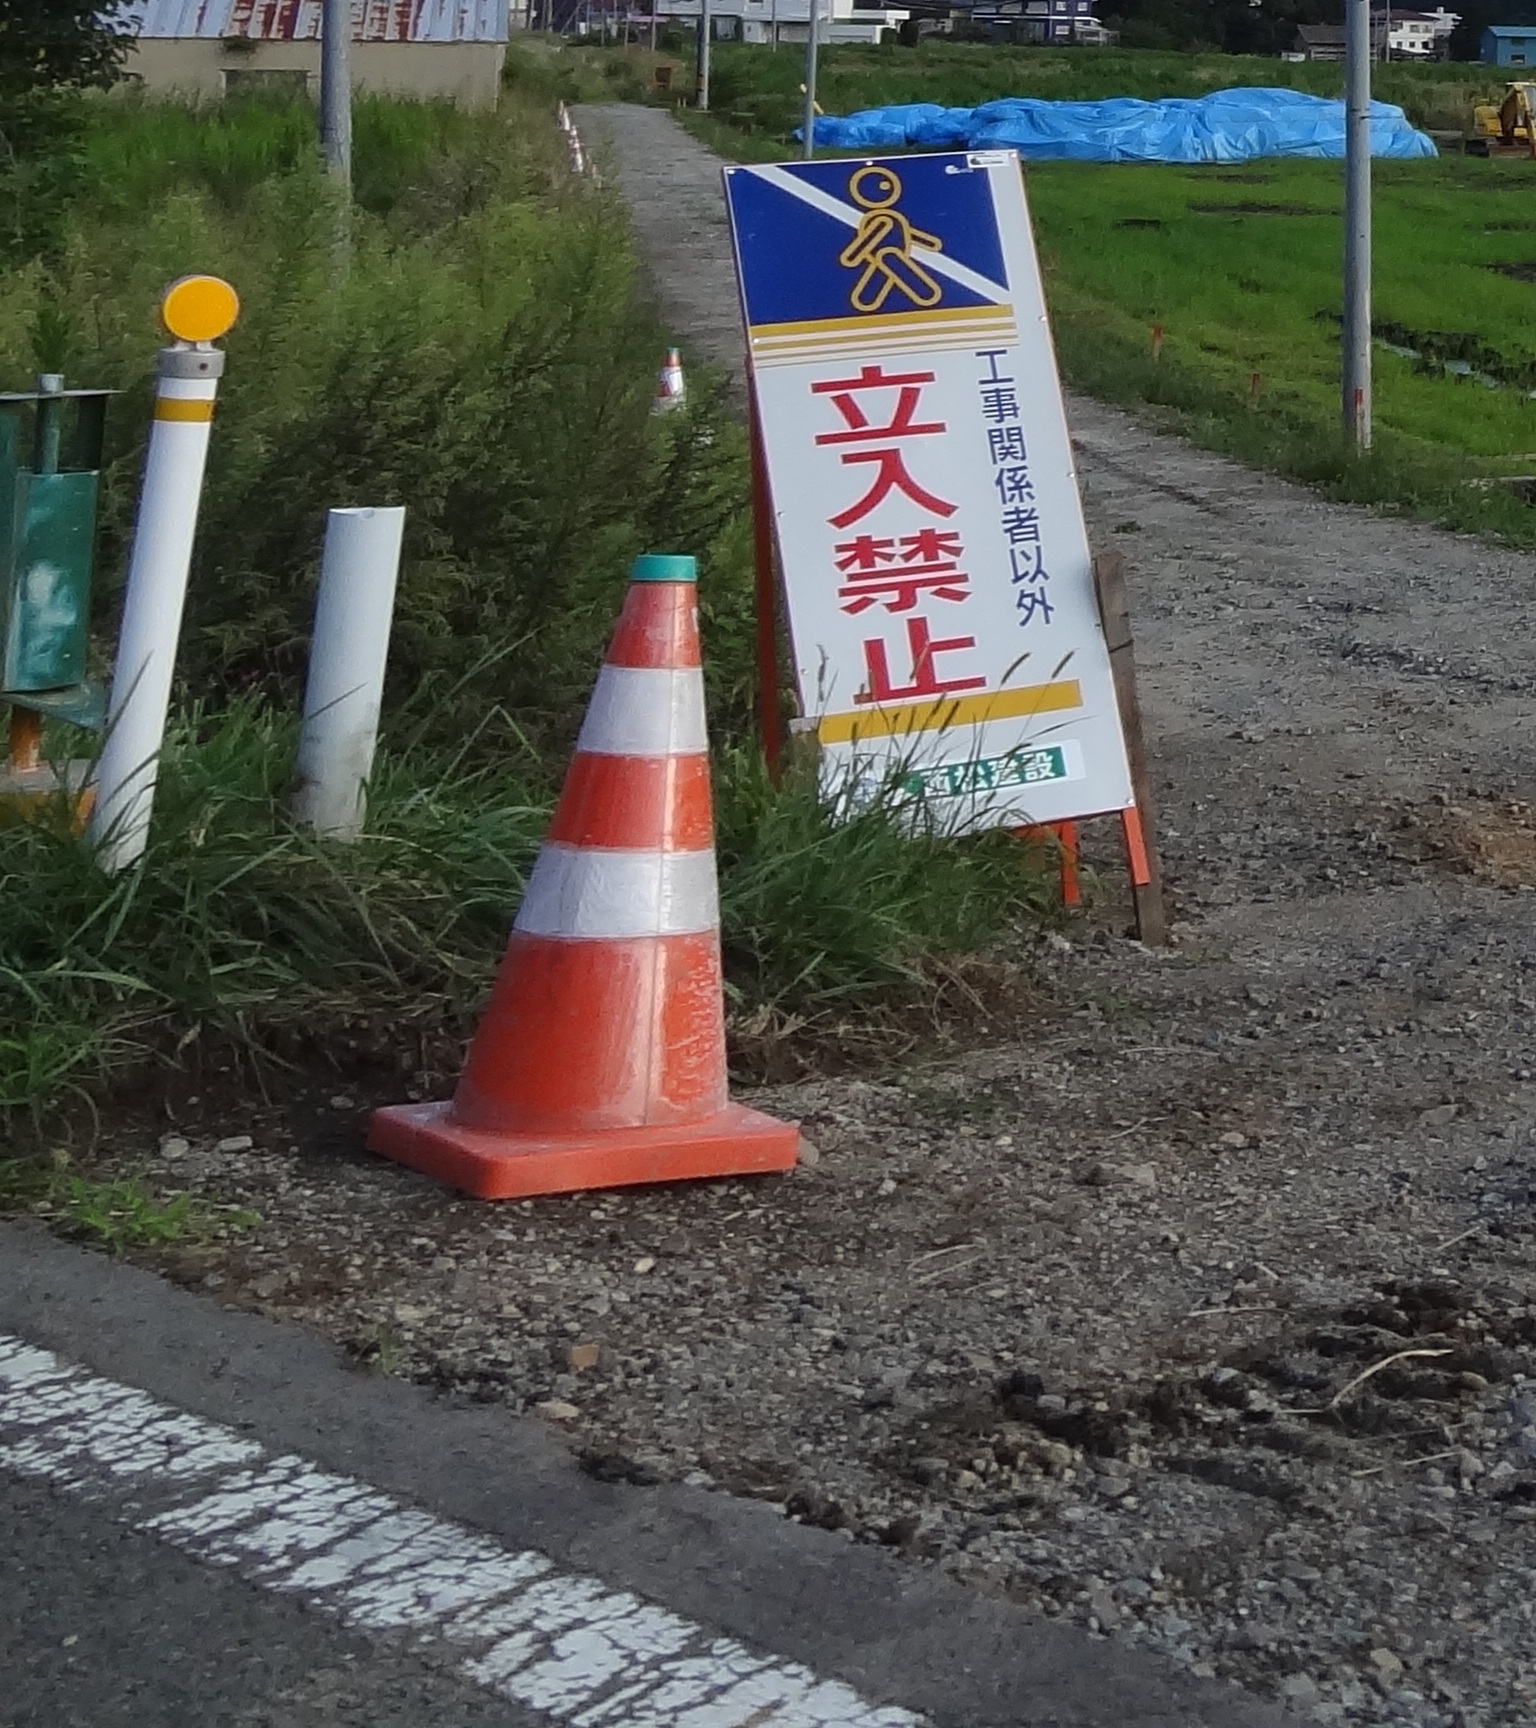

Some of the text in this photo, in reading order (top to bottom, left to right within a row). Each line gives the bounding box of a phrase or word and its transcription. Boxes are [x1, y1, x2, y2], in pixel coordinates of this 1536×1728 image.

[811, 366, 986, 704] 立入禁止
[975, 349, 1054, 627] 工事関係者以外
